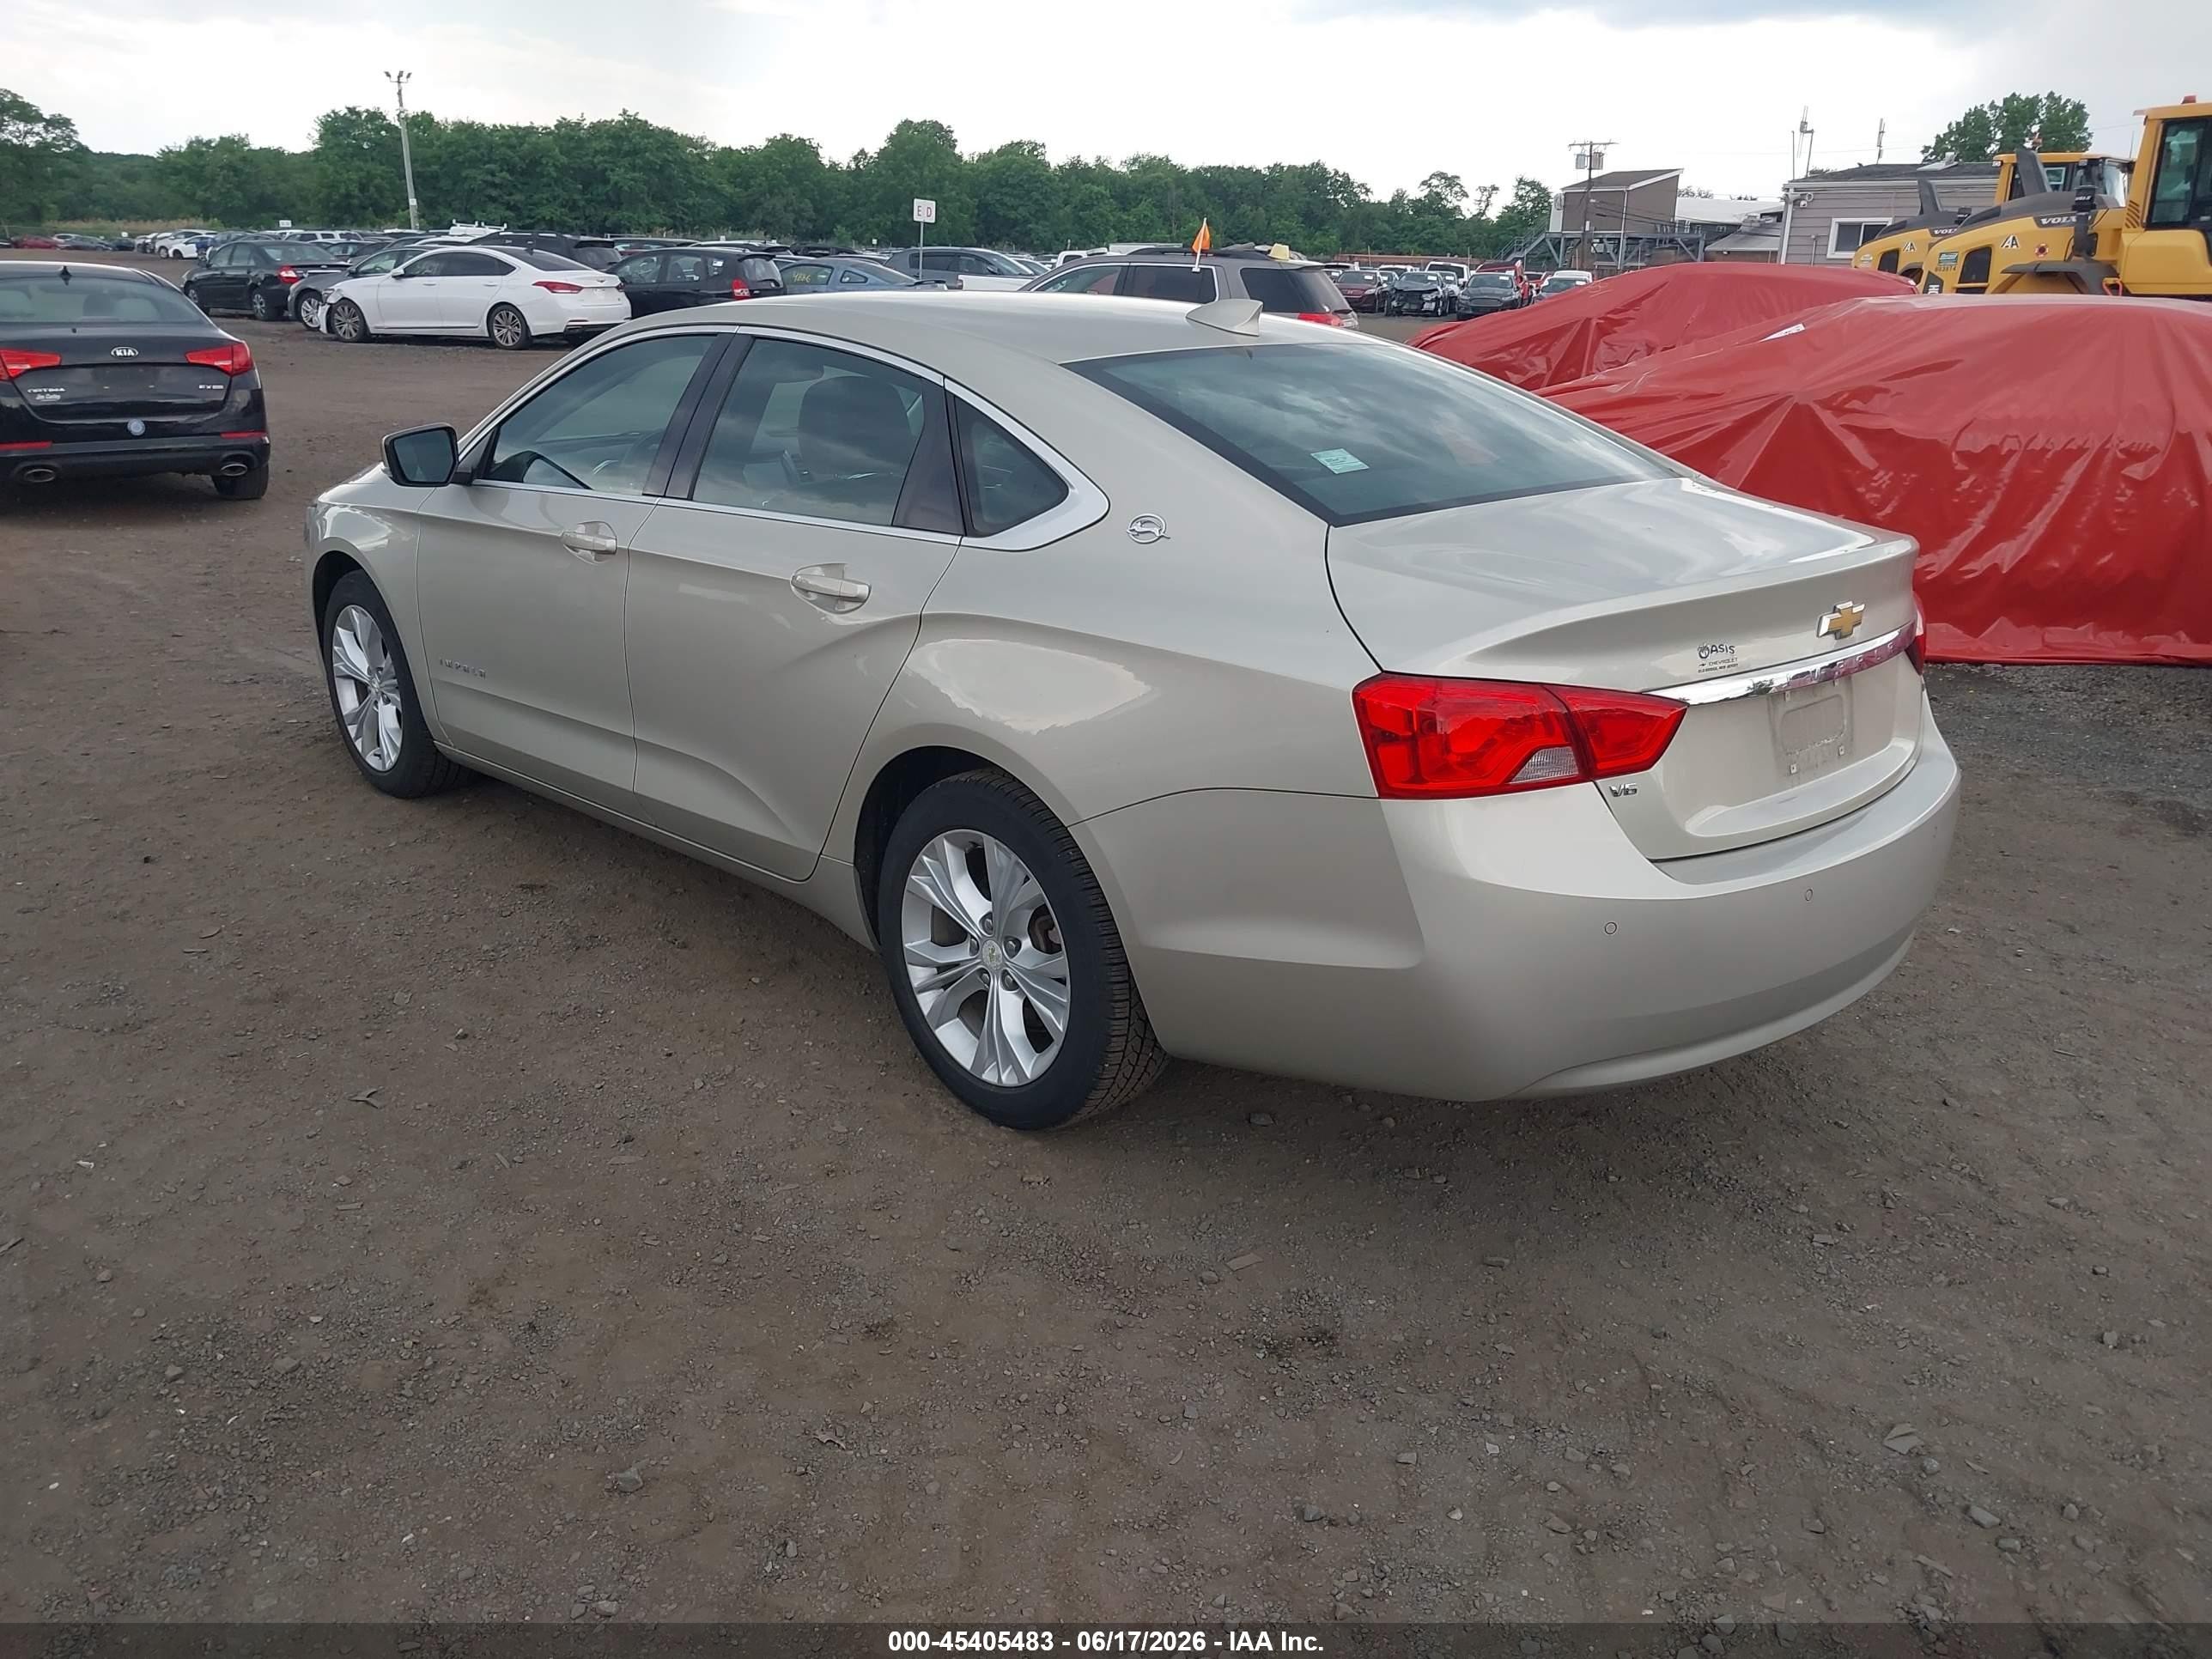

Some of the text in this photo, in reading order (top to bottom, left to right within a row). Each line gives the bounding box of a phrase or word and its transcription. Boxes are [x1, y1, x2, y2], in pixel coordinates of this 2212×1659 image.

[917, 205, 933, 217] E D
[115, 348, 136, 356] KIA
[1608, 783, 1638, 797] V6
